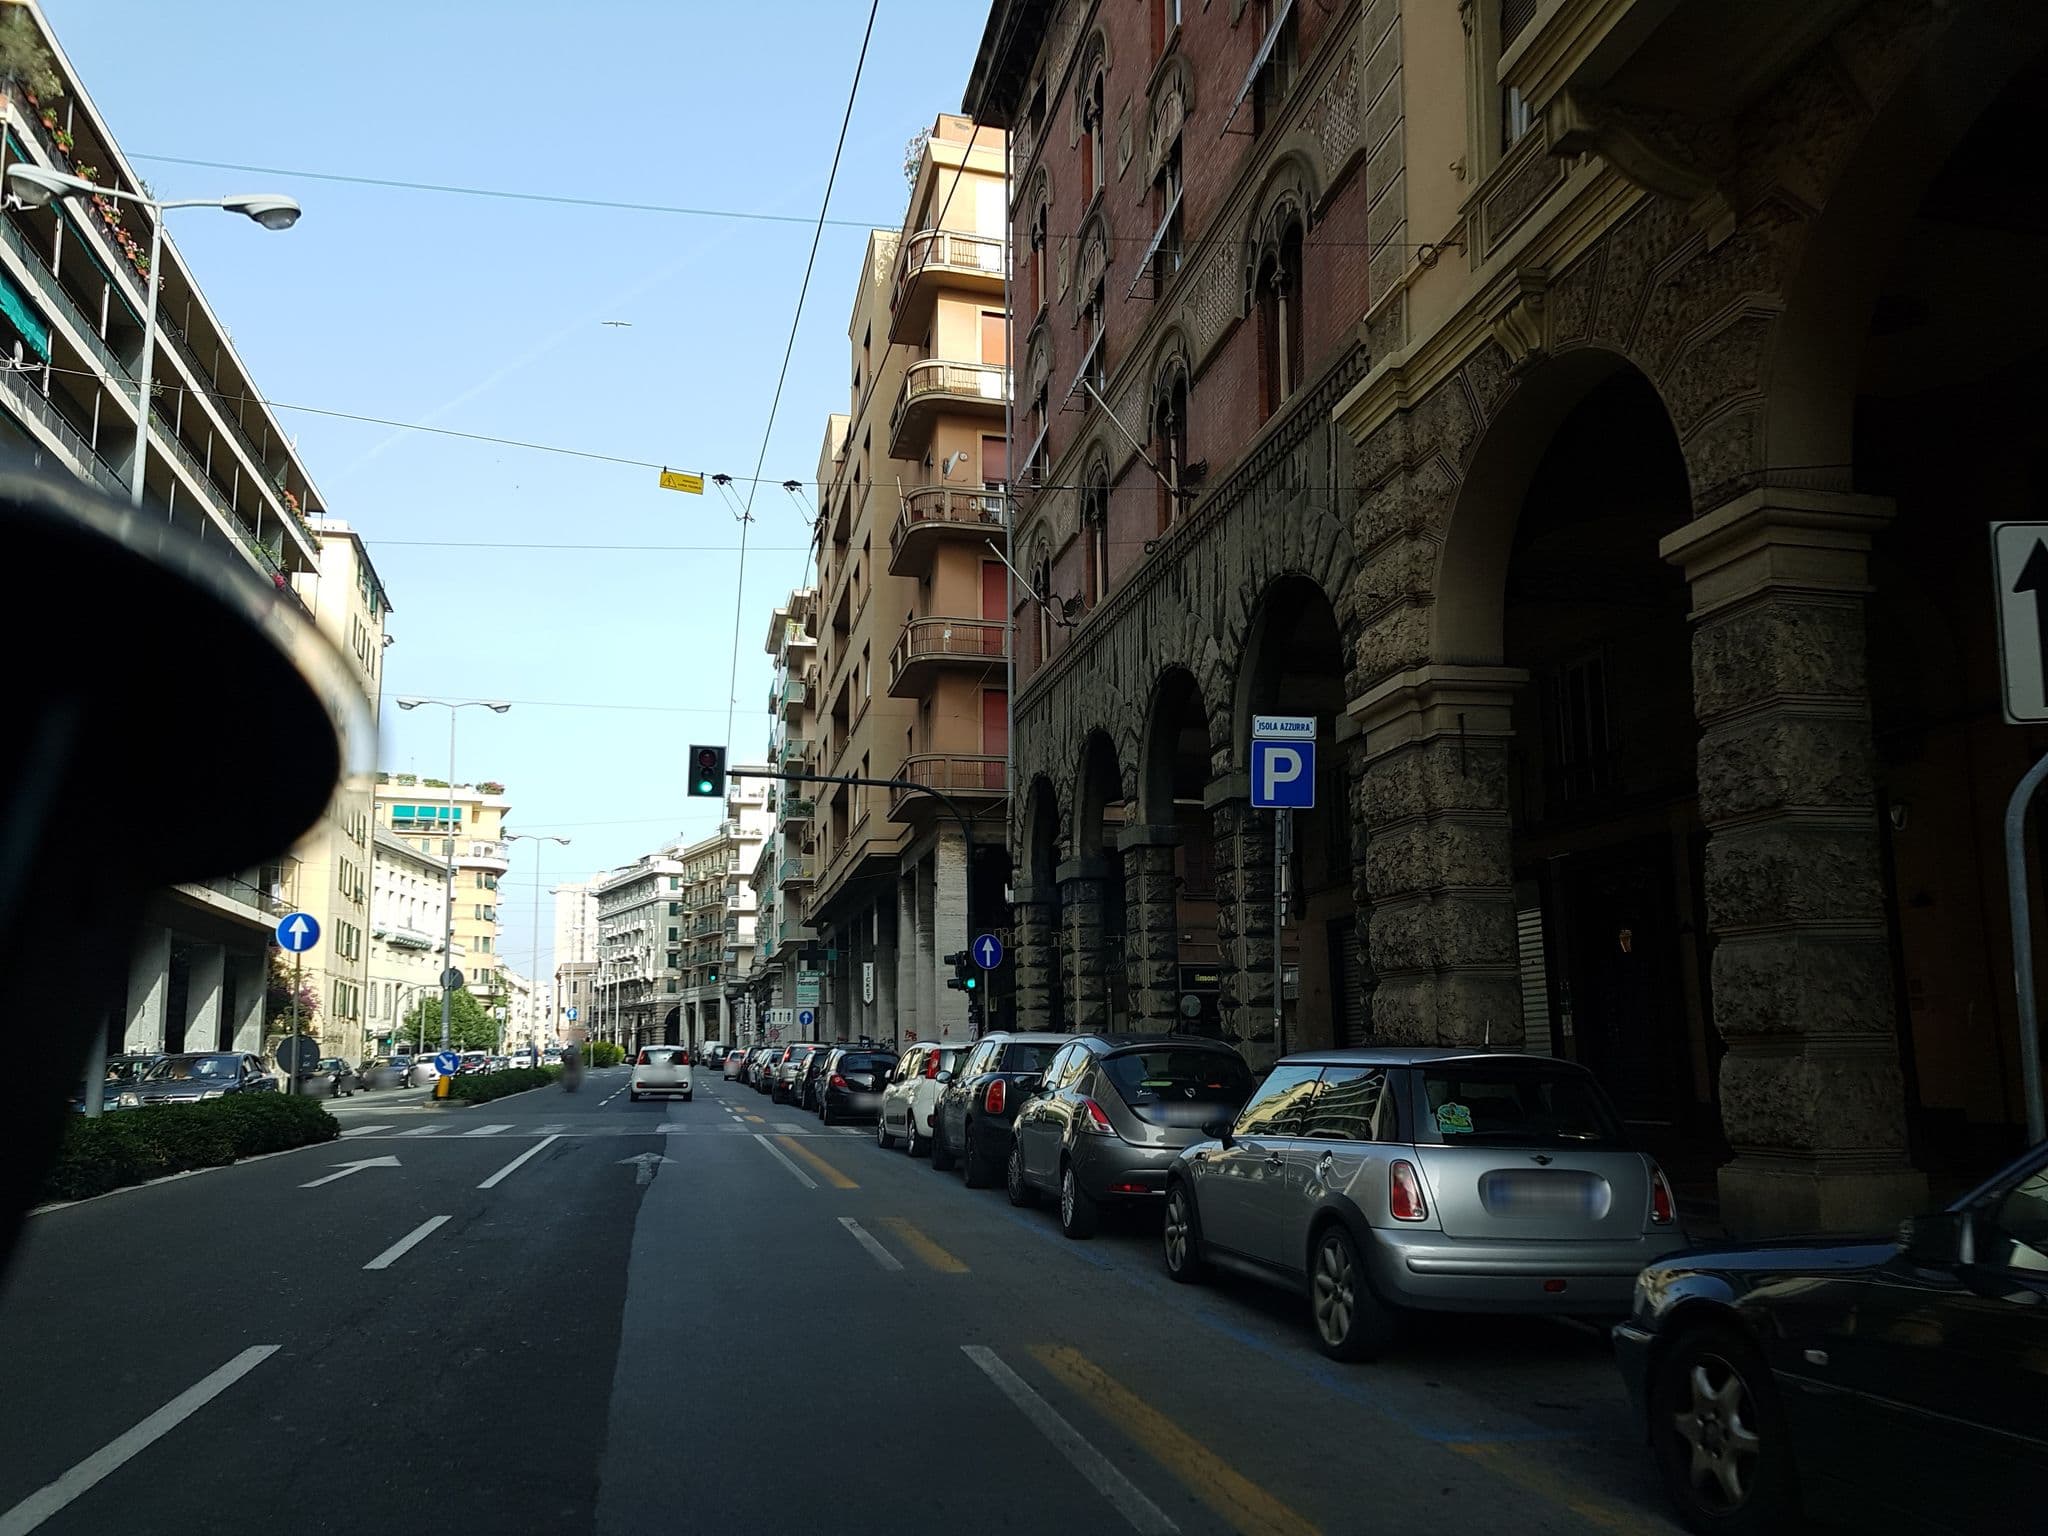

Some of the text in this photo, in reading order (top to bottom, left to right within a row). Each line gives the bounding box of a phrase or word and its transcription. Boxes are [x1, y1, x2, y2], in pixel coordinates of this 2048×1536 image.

[1259, 722, 1310, 732] ISOLA AZZURRA
[1264, 748, 1302, 800] P
